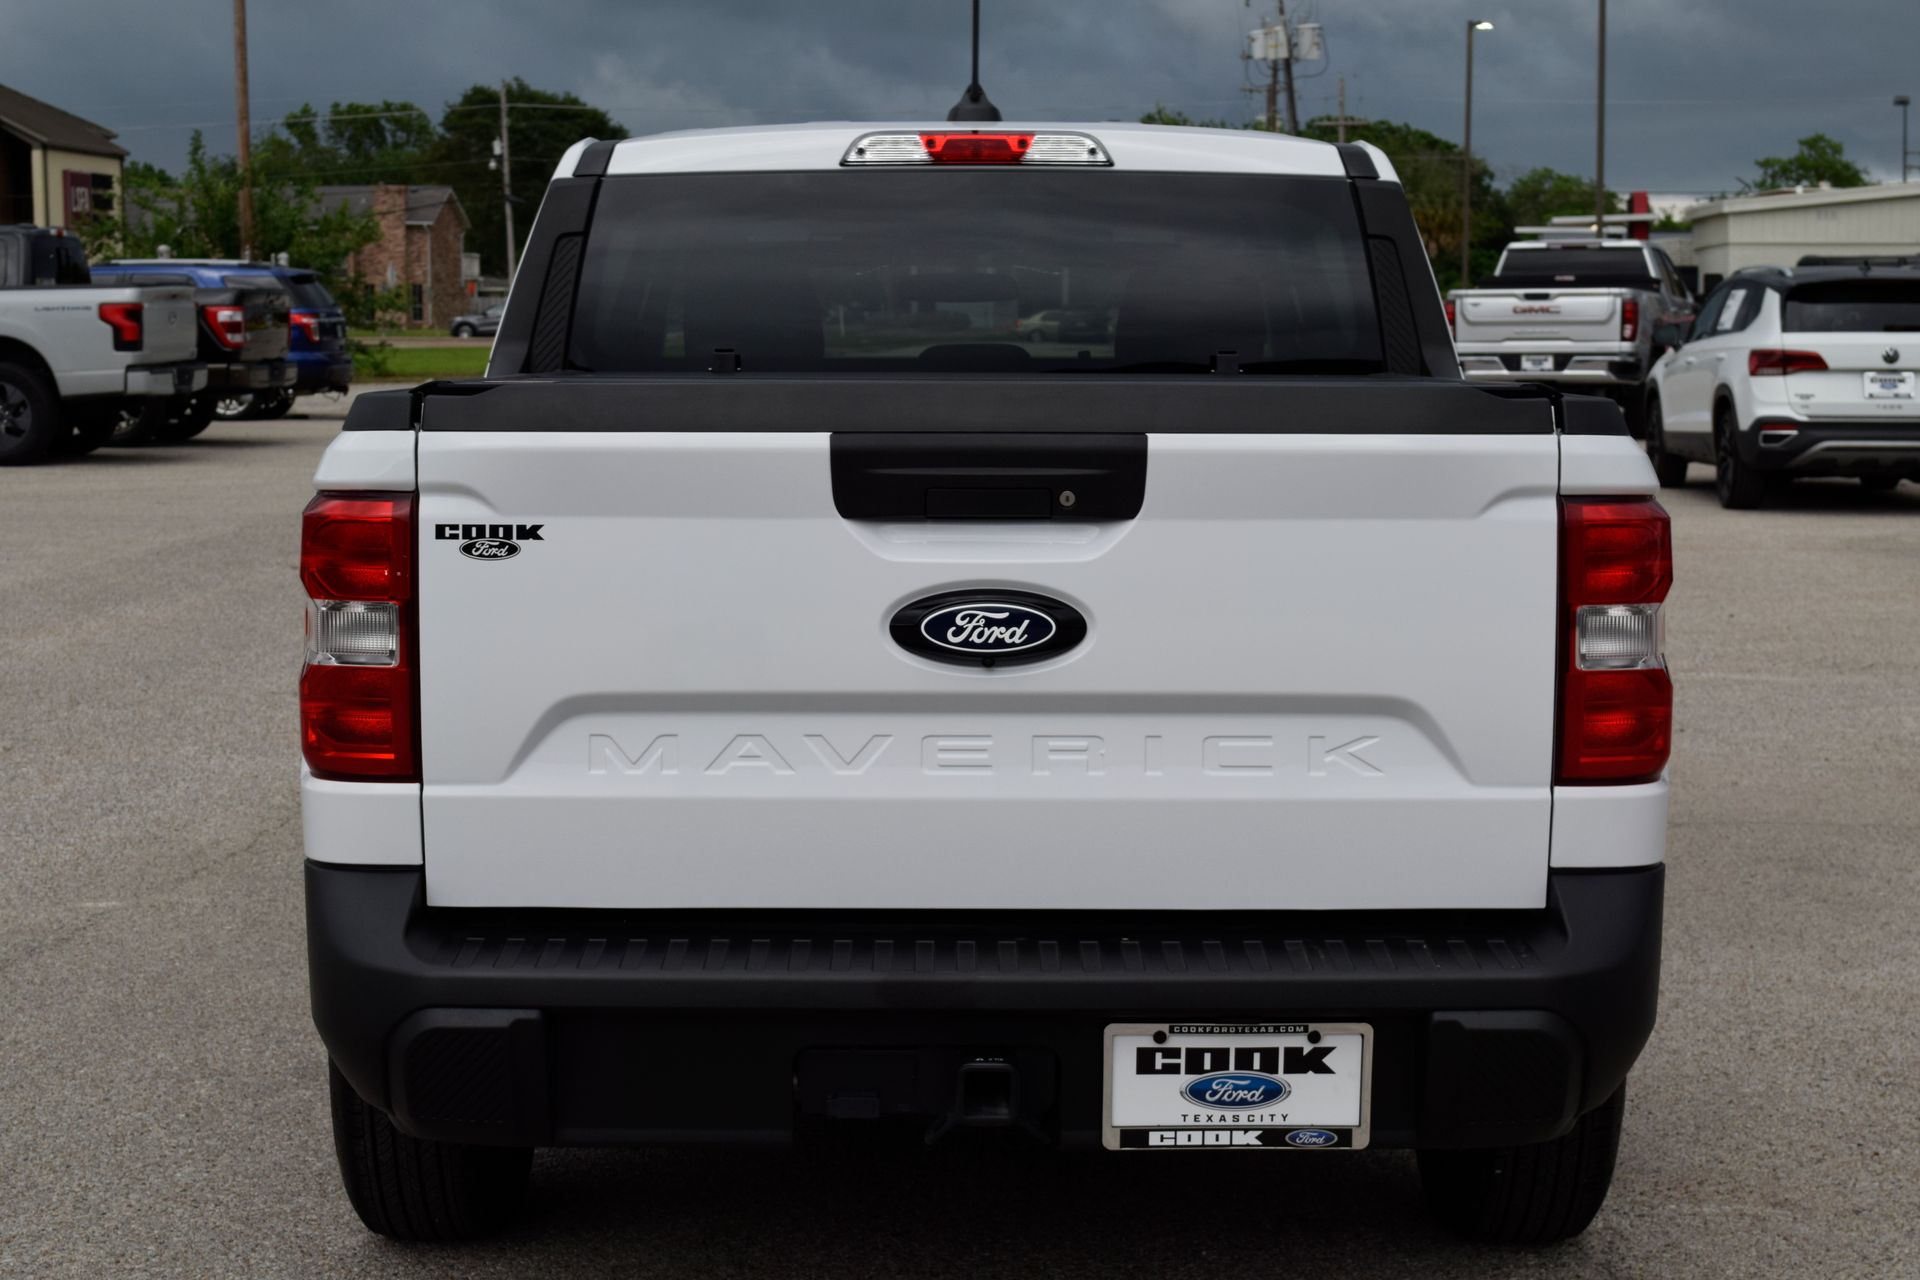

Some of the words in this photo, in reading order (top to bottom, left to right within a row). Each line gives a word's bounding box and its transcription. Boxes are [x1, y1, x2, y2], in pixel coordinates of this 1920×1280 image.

[435, 524, 545, 540] COOK
[471, 540, 509, 556] Ford
[946, 610, 1031, 644] Ford
[588, 734, 1385, 777] MAVERICK
[1136, 1047, 1337, 1075] COOK
[1205, 1078, 1265, 1102] Ford
[1181, 1114, 1240, 1123] TEXAS
[1246, 1113, 1289, 1122] CITY
[1149, 1130, 1264, 1146] COOK
[1295, 1132, 1326, 1145] Ford
